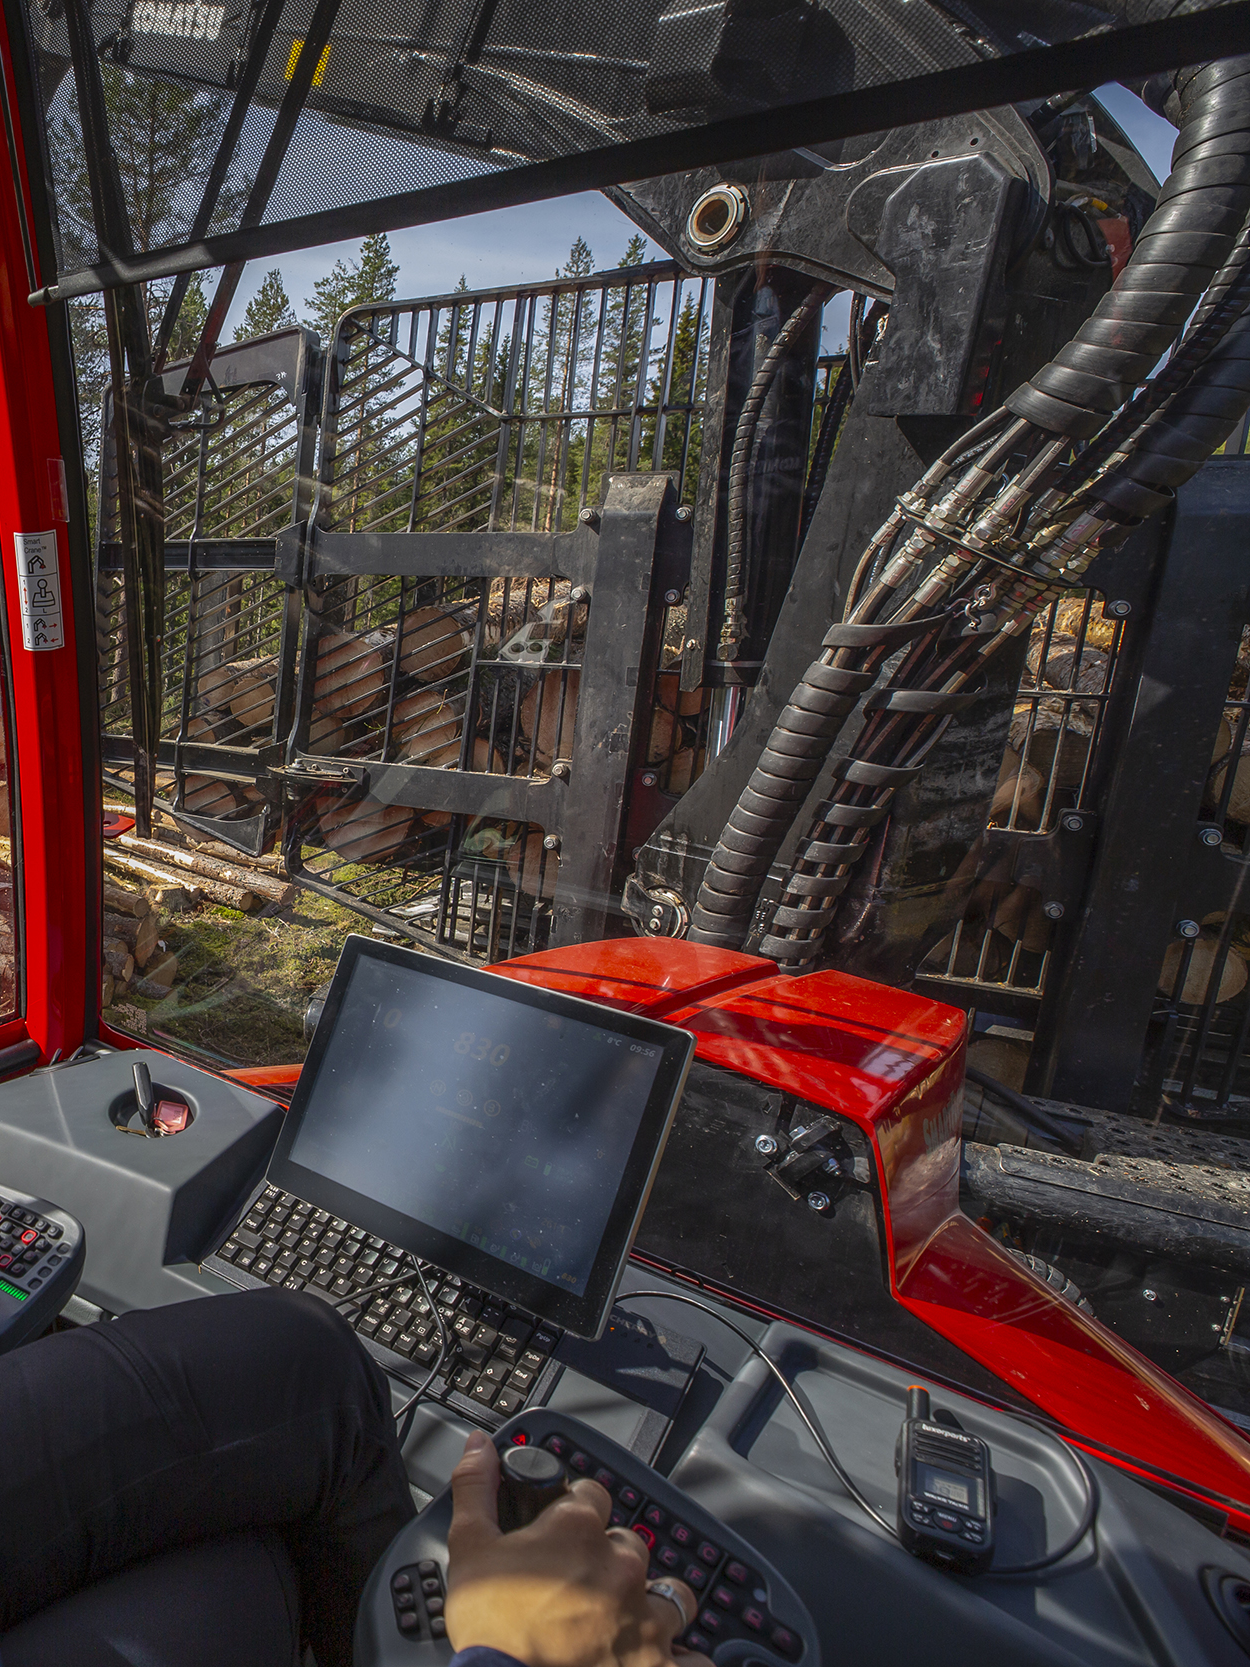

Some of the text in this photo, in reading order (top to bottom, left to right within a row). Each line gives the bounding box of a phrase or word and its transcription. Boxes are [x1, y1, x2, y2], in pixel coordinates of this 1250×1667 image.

[453, 1031, 511, 1067] 830
[629, 1044, 656, 1058] 09:56
[400, 1333, 411, 1343] Ctrl
[536, 1332, 551, 1343] PgUp
[419, 1343, 428, 1352] Ins
[525, 1351, 540, 1362] PgDn
[515, 1369, 528, 1379] End
[649, 1510, 660, 1523] A
[675, 1528, 689, 1541] B
[662, 1550, 676, 1564] E
[702, 1546, 716, 1560] C
